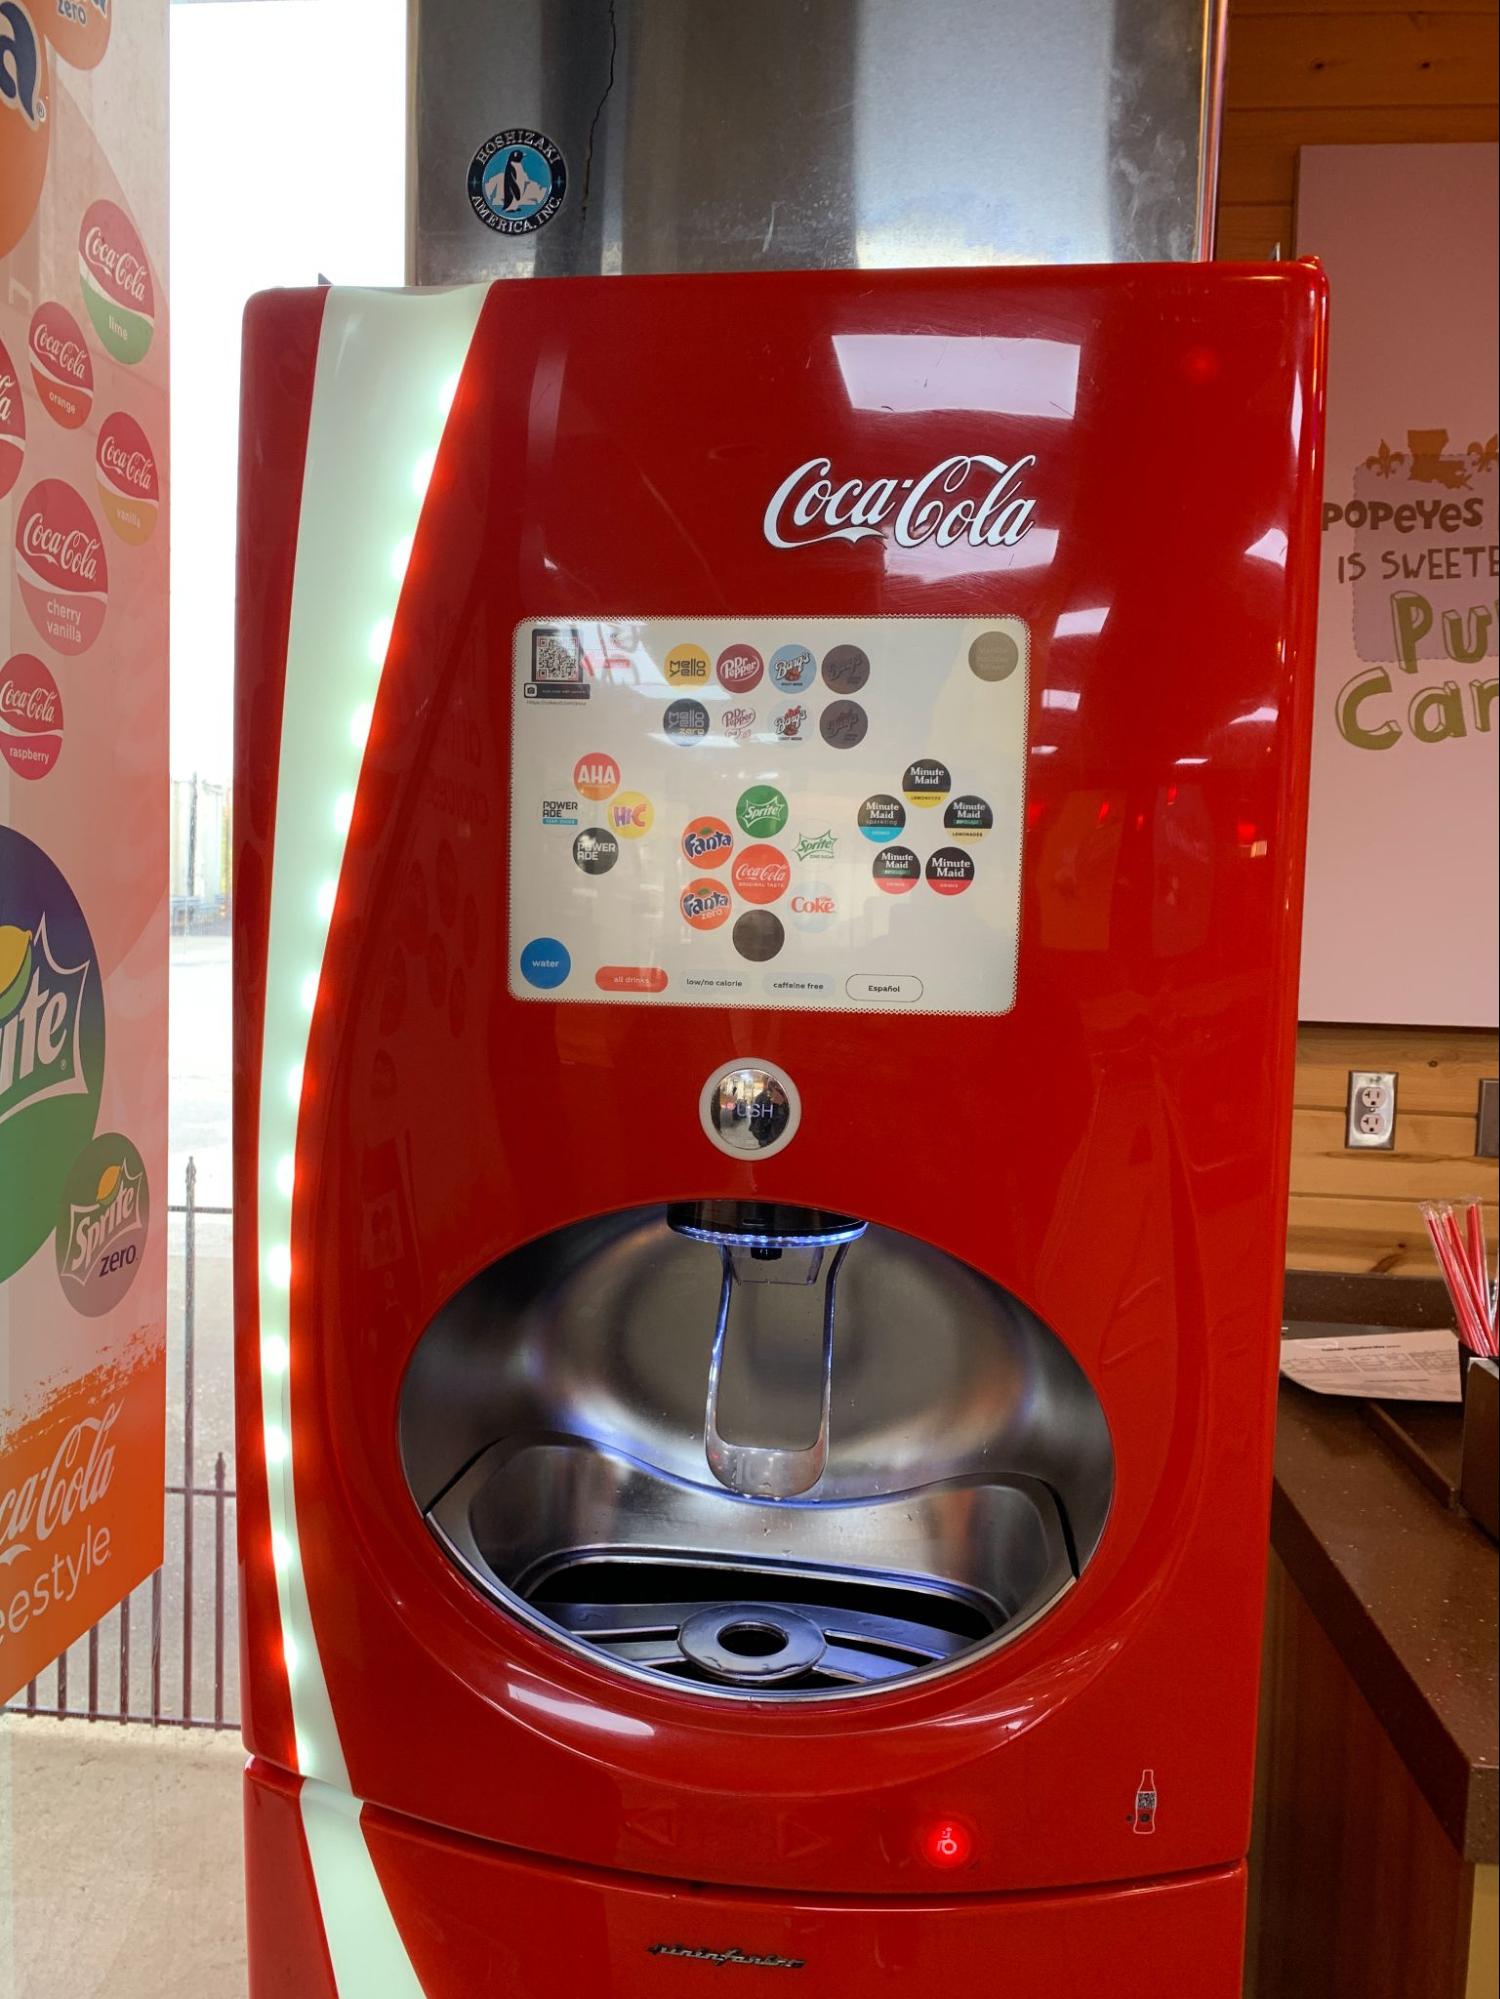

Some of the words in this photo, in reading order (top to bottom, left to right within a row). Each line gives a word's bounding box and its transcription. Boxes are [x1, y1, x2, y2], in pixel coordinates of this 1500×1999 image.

[475, 130, 561, 165] HOSHIZAKI
[85, 226, 147, 301] Coca-Cola
[108, 315, 128, 341] lime
[34, 323, 87, 380] Coca-Cola
[48, 390, 76, 415] orange
[101, 436, 154, 490] Coca-Cola
[763, 454, 1037, 548] Coca-Cola
[116, 506, 142, 529] vanilla
[23, 512, 101, 581] Coca-Cola
[1338, 552, 1366, 584] IS
[47, 599, 82, 626] cherry
[46, 620, 82, 643] vanilla
[1390, 590, 1499, 674] Pu
[721, 659, 758, 680] Pepper
[9, 746, 50, 766] raspberry
[578, 764, 616, 784] AHA
[910, 766, 945, 776] Minute
[914, 776, 939, 785] Maid
[543, 801, 578, 810] POWER
[746, 804, 780, 820] Sprite
[865, 801, 899, 811] Minute
[870, 810, 894, 819] Maid
[953, 801, 986, 811] Minute
[957, 810, 981, 819] Maid
[577, 842, 616, 852] POWER
[684, 831, 732, 858] Fanta
[800, 837, 832, 852] Sprite
[881, 852, 914, 861] Minute
[885, 860, 909, 869] Maid
[931, 857, 971, 868] Minute
[936, 867, 965, 877] Maid
[683, 891, 729, 917] Fanta
[790, 896, 836, 914] Coke
[532, 959, 559, 968] water
[613, 976, 624, 984] all
[625, 976, 650, 985] drinks
[686, 979, 714, 987] low/no
[715, 980, 743, 988] calorie
[773, 982, 805, 990] caffeine
[868, 985, 901, 994] Español
[734, 1103, 774, 1118] USH
[71, 1180, 135, 1272] Sprite
[99, 1245, 137, 1279] zero
[0, 1397, 125, 1558] ca-Cola
[4, 1524, 111, 1636] estyle
